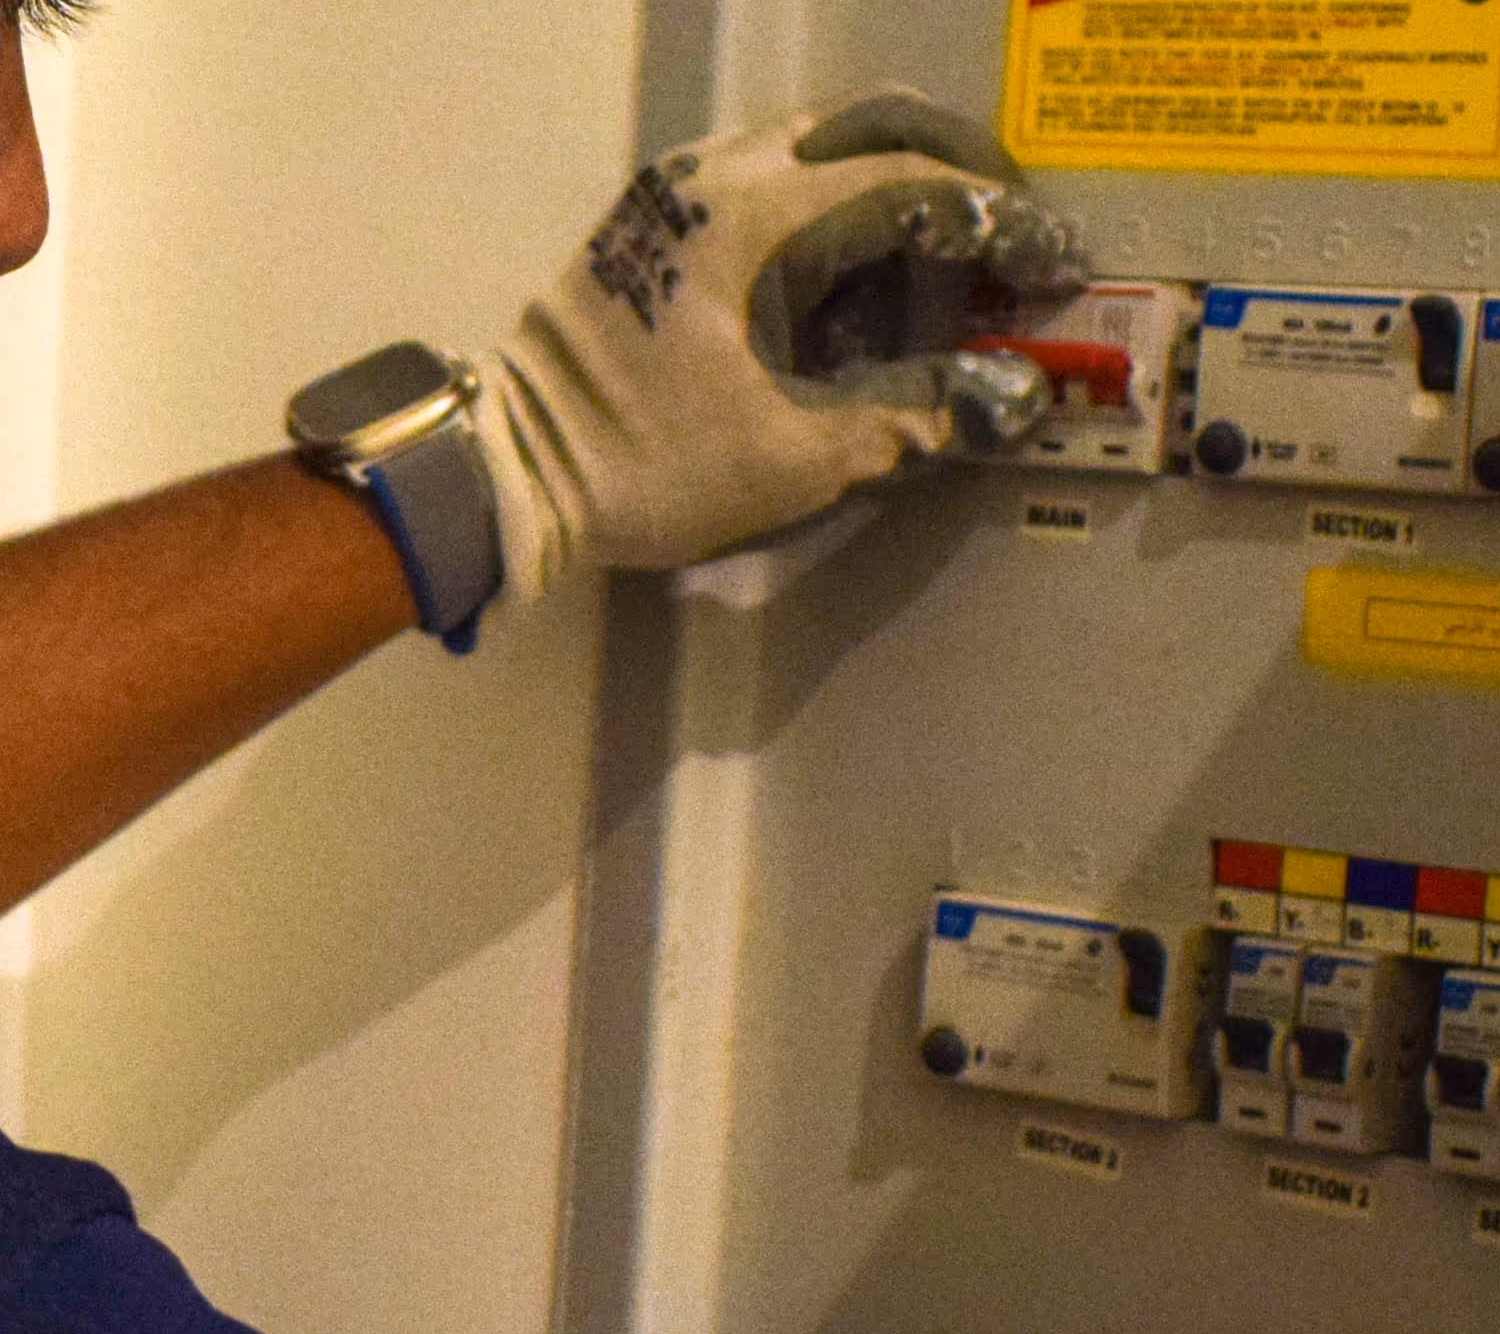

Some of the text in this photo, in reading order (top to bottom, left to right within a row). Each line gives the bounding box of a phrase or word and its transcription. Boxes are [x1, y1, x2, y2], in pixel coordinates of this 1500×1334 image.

[1027, 505, 1087, 529] MAIN
[1311, 513, 1398, 542] SECTION
[1267, 1166, 1351, 1206] SECTION
